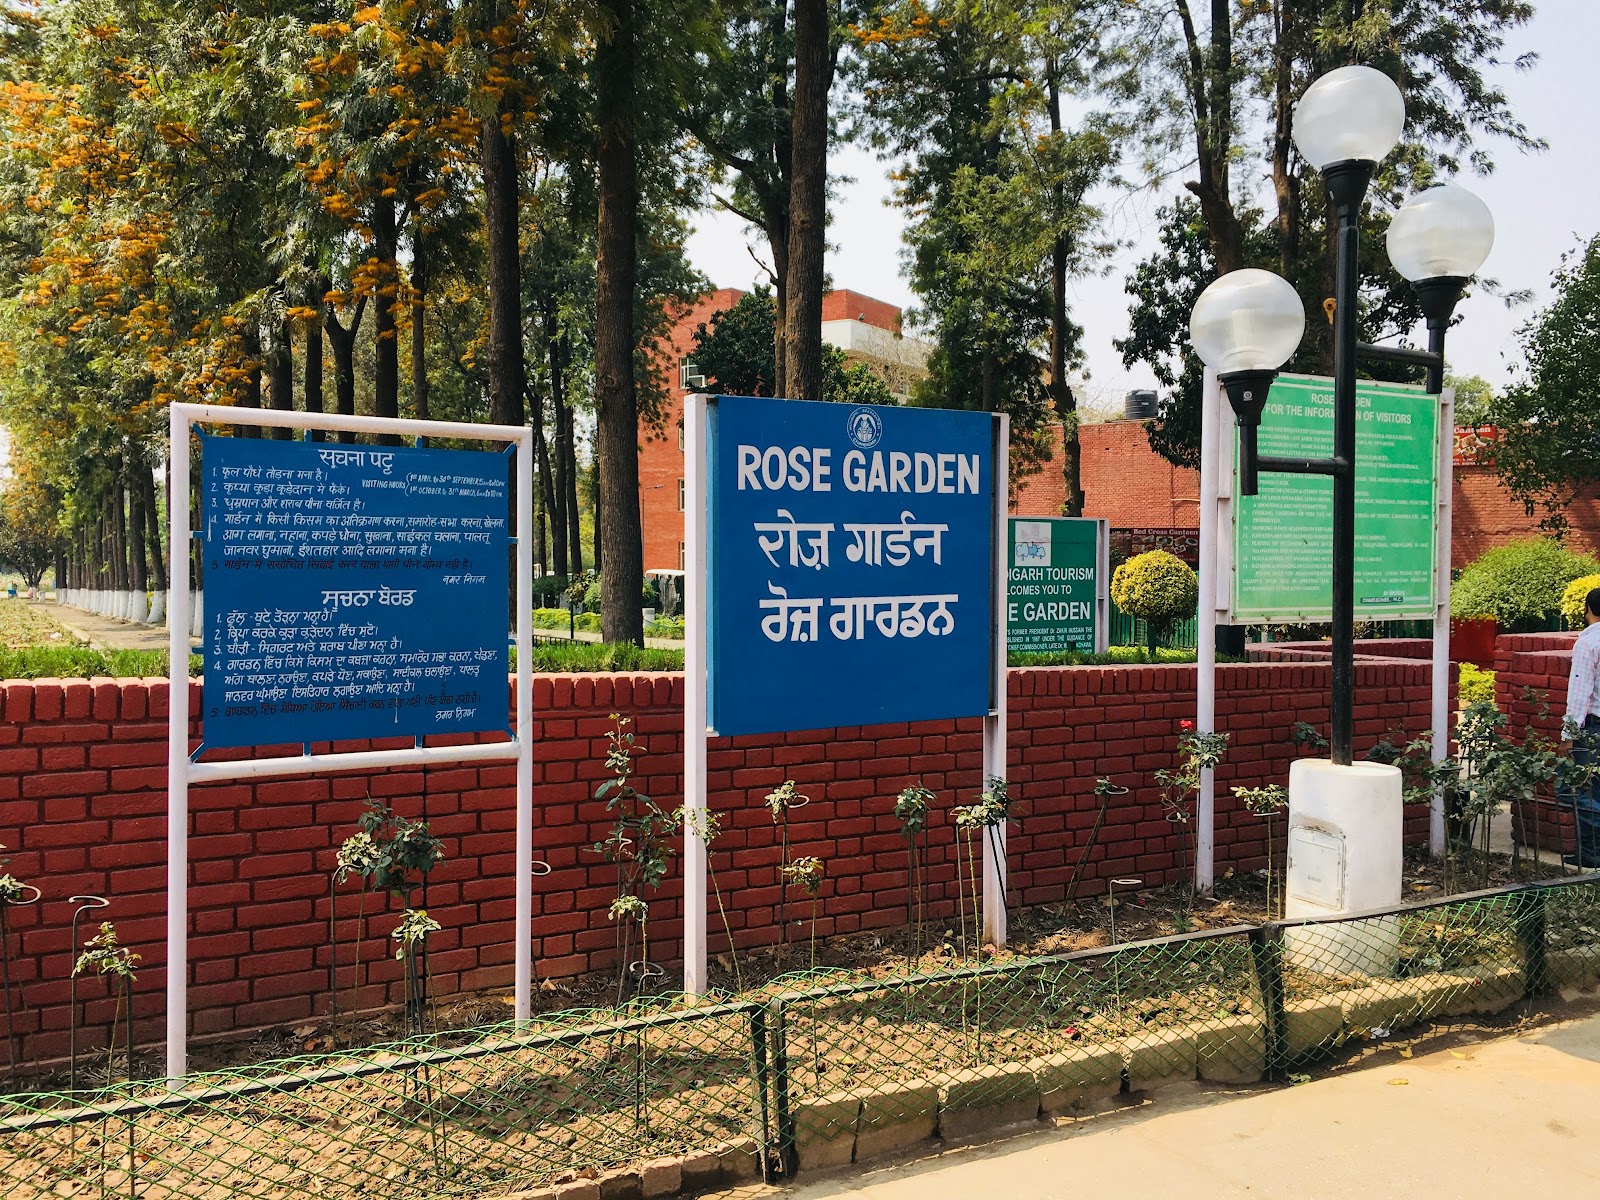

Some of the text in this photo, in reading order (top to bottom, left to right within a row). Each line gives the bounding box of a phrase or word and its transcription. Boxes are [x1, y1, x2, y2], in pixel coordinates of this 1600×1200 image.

[1265, 404, 1412, 424] FOR THE OF VISITORS
[318, 449, 365, 468] सूचना
[222, 466, 242, 480] फूल
[243, 464, 262, 478] पौधे
[266, 465, 295, 481] तोड़ना
[297, 470, 314, 480] मना
[737, 444, 980, 495] ROSE GARDEN
[362, 479, 406, 489] VISITING HOURS
[418, 487, 442, 495] OCTOBER
[261, 496, 279, 509] और
[280, 498, 304, 510] शराब
[304, 497, 324, 510] पीना
[325, 498, 351, 510] वर्जित
[224, 511, 252, 525] गार्डन
[267, 511, 291, 525] किसी
[293, 512, 323, 526] किसम
[325, 516, 342, 526] का
[341, 513, 383, 527] अतिक्रमण
[222, 529, 246, 541] आग
[311, 527, 339, 543] कपड़े
[396, 528, 432, 544] साईकल
[463, 531, 492, 545] पालतू
[754, 508, 950, 571] रोज़ गार्डन
[1148, 528, 1168, 536] Cross
[223, 545, 260, 556] जानवर
[341, 542, 365, 557] आदि
[366, 545, 397, 556] लगाना
[399, 546, 419, 556] मना
[1008, 567, 1094, 581] IGARH TOURISM
[1042, 585, 1059, 595] YOU
[1061, 584, 1073, 595] TO
[321, 584, 418, 613] ਸੂਚਨਾ ਬੋਰਡ
[759, 580, 959, 643] ਰੋਜ਼ ਗਾਰਡਨ
[1023, 601, 1091, 622] GARDEN
[252, 624, 278, 639] ਕਰਕੇ
[338, 623, 357, 637] ਵਿੱਚ
[226, 640, 250, 656] ਬੀੜੀ
[258, 640, 295, 655] ਸਿਗਰਟ
[296, 639, 317, 653] ਅਤੇ
[227, 658, 262, 673] ਗਾਰਡਨ
[264, 654, 284, 670] ਵਿੱਚ
[285, 654, 306, 669] ਕਿਸੇ
[307, 653, 334, 668] ਕਿਸਮ
